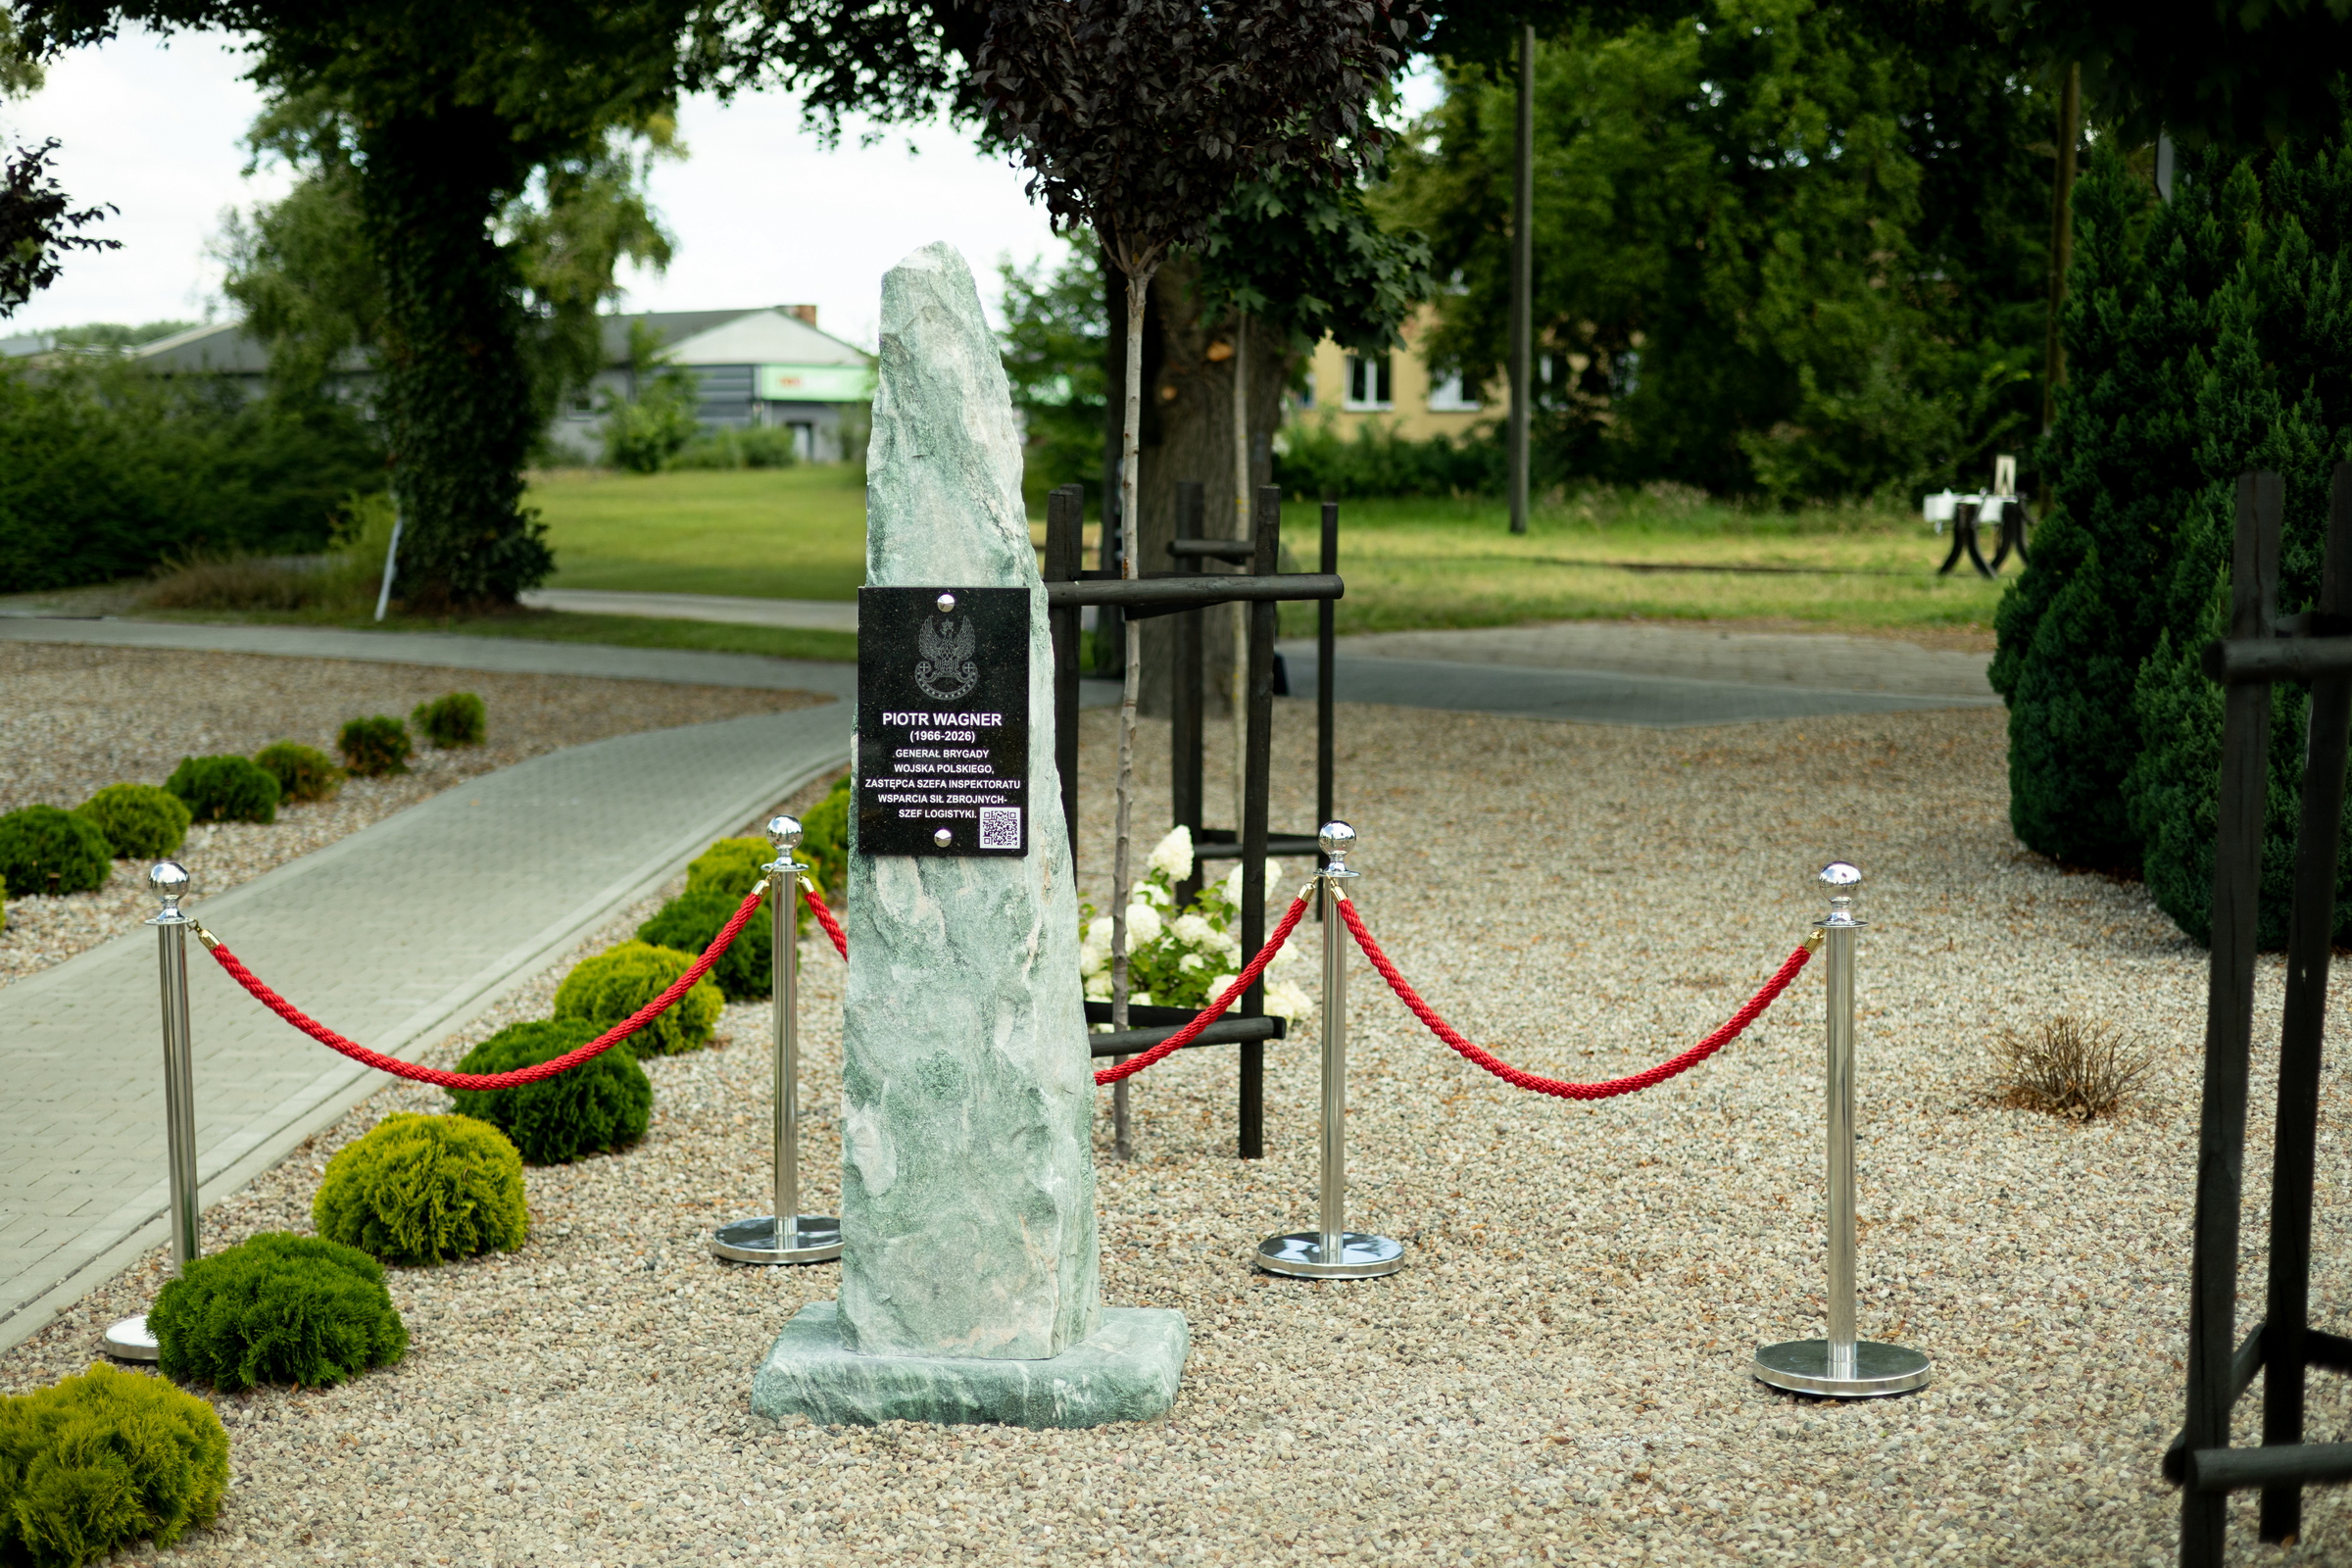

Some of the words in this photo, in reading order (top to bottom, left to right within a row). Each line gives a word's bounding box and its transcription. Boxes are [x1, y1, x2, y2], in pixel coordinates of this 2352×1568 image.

[883, 711, 929, 726] PIOTR
[933, 712, 1002, 726] WAGNER
[909, 730, 975, 743] (1966-2026)
[896, 749, 941, 759] GENERAŁ
[943, 749, 989, 759] BRYGADY
[894, 763, 935, 773] WOJSKA
[937, 764, 995, 774] POLSKIEGO,
[865, 779, 915, 790] ZASTĘPCA
[916, 779, 947, 789] SZEFA
[949, 779, 1021, 789] INSPEKTORATU
[878, 794, 928, 804] WSPARCIA
[929, 794, 944, 804] SIŁ
[946, 794, 1007, 804] ZBROJNYCH-
[899, 808, 922, 818] SZEF
[924, 808, 977, 819] LOGISTYKI.
